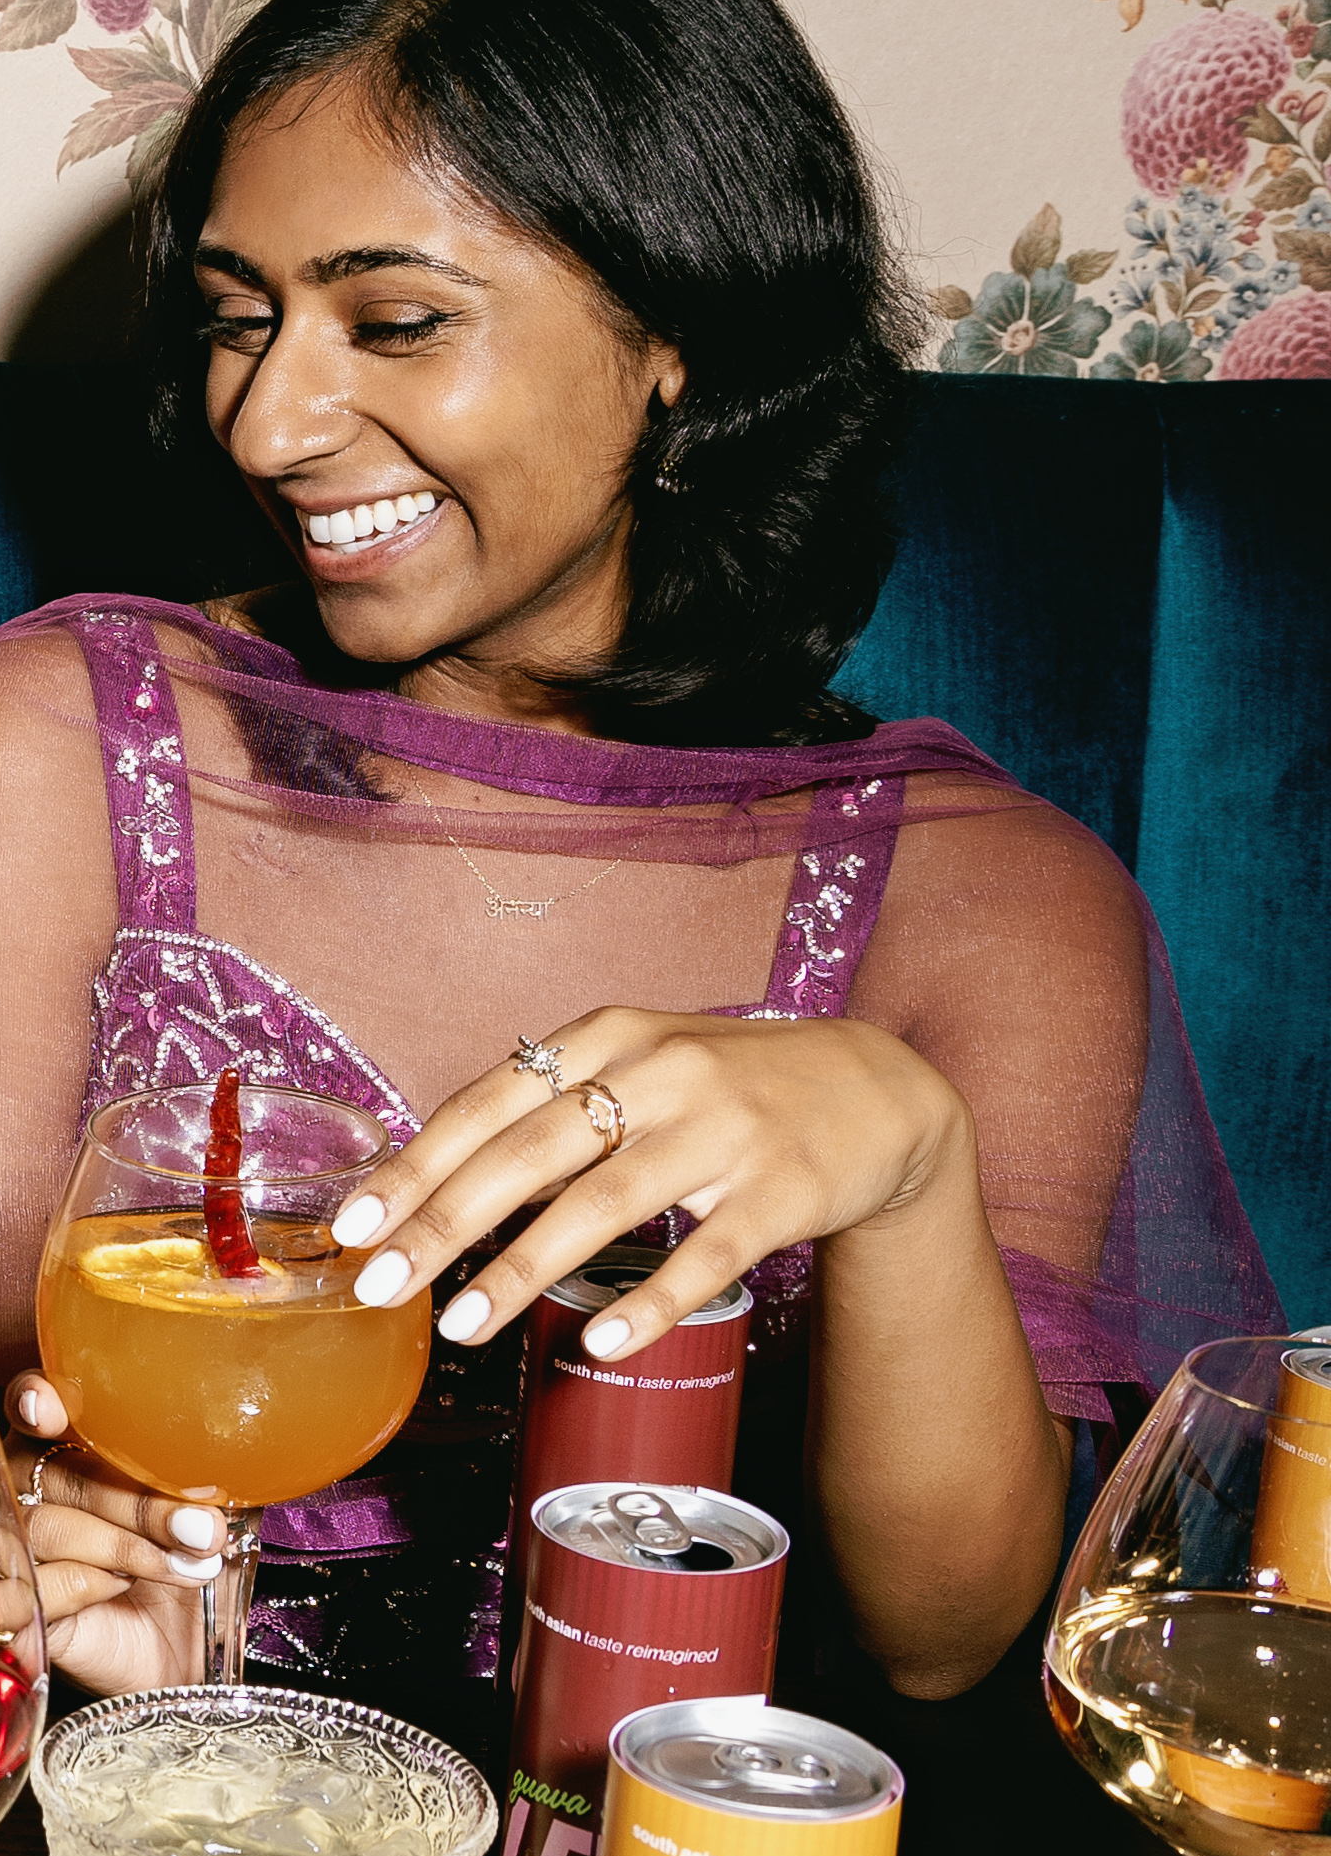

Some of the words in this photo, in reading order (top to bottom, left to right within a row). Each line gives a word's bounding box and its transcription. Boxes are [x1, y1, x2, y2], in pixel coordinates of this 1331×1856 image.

[553, 1357, 591, 1380] south
[592, 1368, 635, 1388] asian
[636, 1373, 673, 1391] taste
[674, 1368, 736, 1390] reimagined
[1296, 1446, 1327, 1467] taste
[545, 1612, 582, 1642] asian
[582, 1629, 624, 1656] taste
[625, 1641, 719, 1667] reimagined
[508, 1768, 592, 1818] guava
